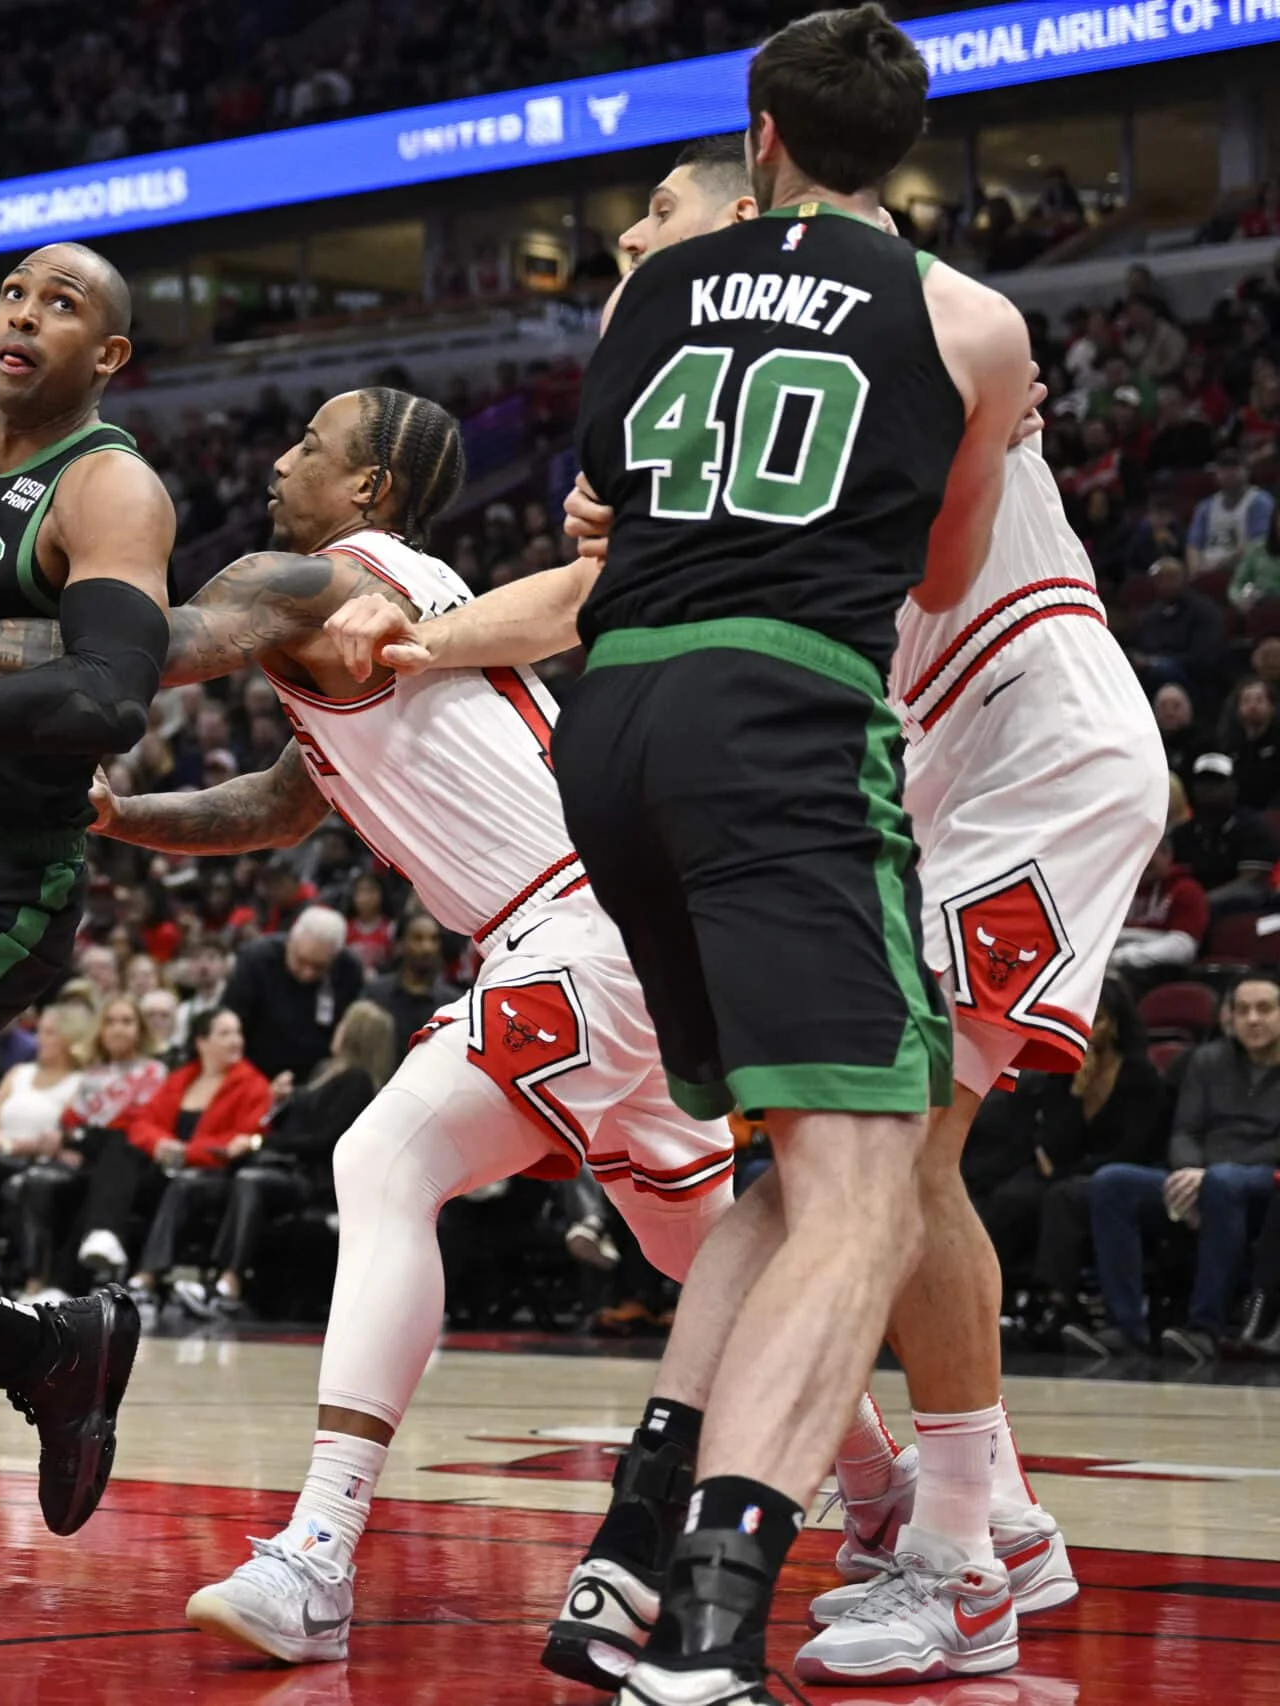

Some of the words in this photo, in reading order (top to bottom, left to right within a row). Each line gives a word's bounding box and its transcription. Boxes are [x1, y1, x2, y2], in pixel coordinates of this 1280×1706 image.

[914, 24, 1029, 77] FICIAL
[1032, 2, 1169, 58] AIRLINE
[1172, 0, 1222, 34] OF
[398, 113, 522, 161] UNITED
[107, 167, 187, 216] BULLS
[690, 273, 872, 335] KORNET
[624, 345, 870, 526] 40
[1, 489, 36, 512] PRINT
[11, 476, 47, 501] VISTA
